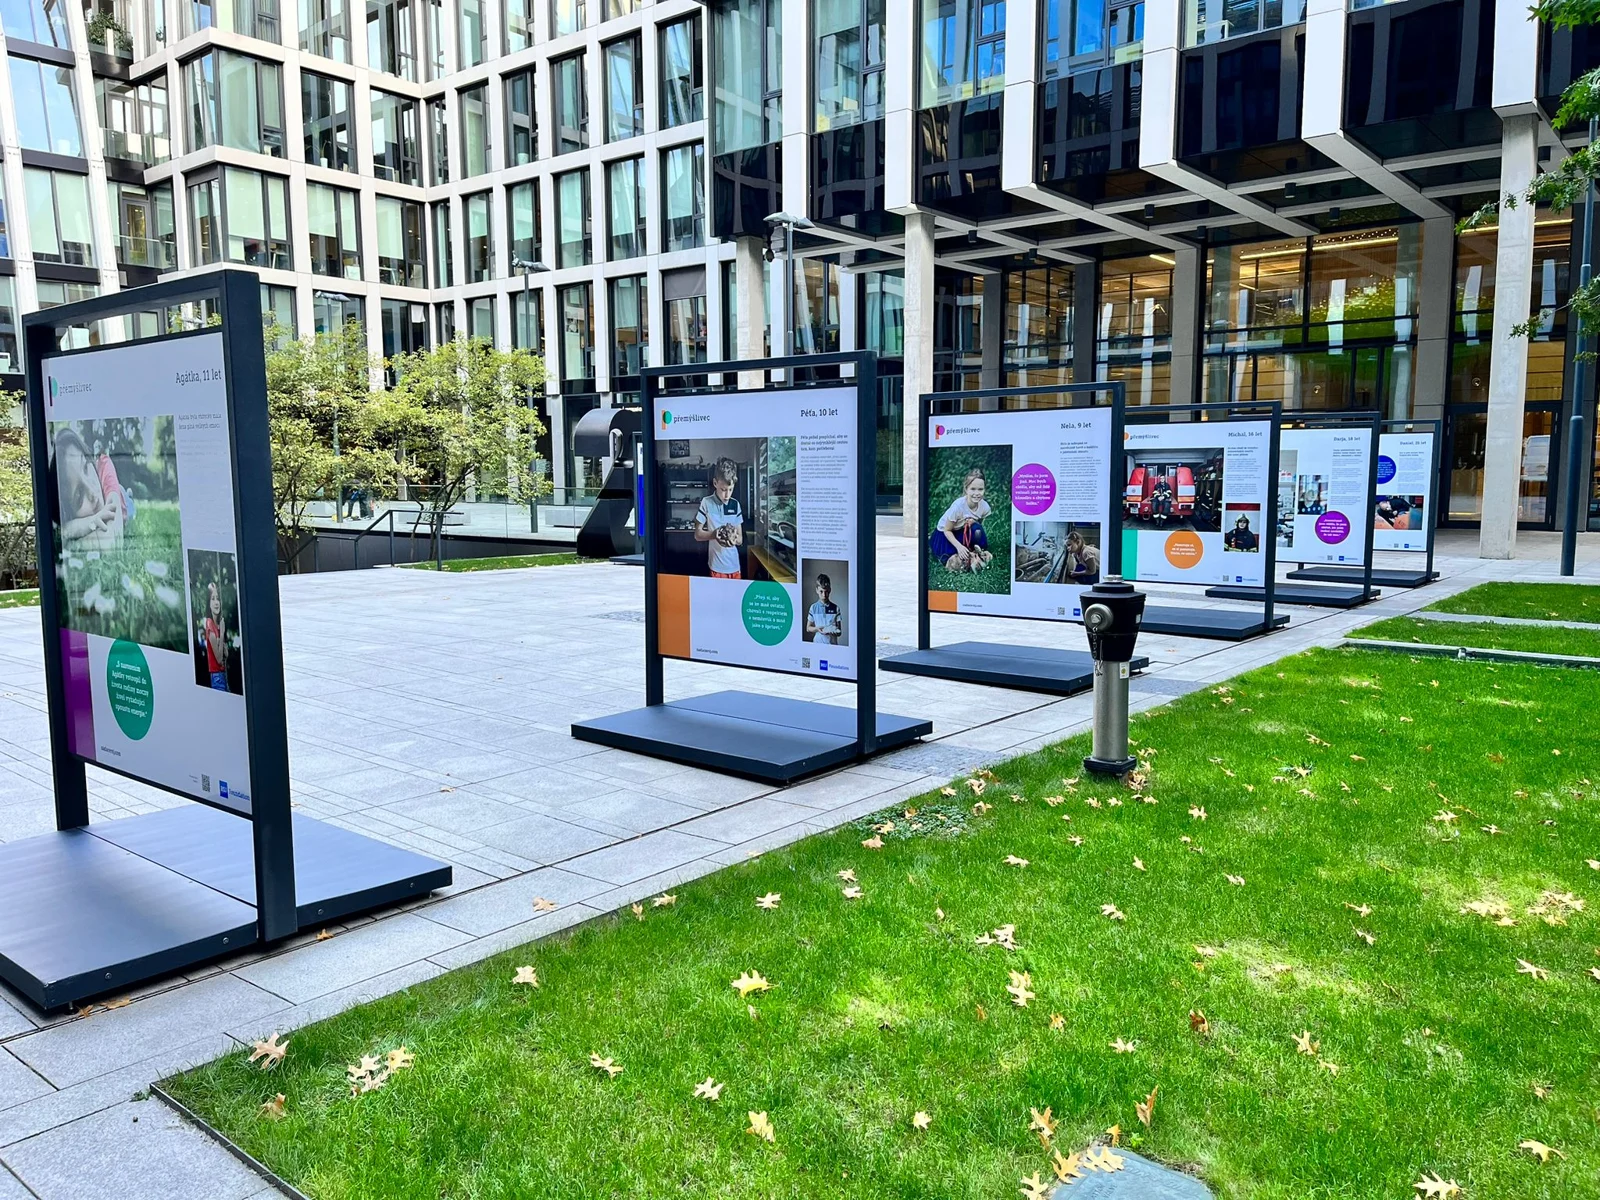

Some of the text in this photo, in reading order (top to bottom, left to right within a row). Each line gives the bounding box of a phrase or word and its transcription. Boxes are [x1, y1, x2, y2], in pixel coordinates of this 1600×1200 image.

[176, 368, 222, 386] Agátka, 11 let
[59, 382, 92, 397] přemýšlivec
[801, 408, 838, 418] Péťa, 10 let
[673, 414, 711, 424] přemýšlivec
[946, 427, 980, 435] přemýšlivec
